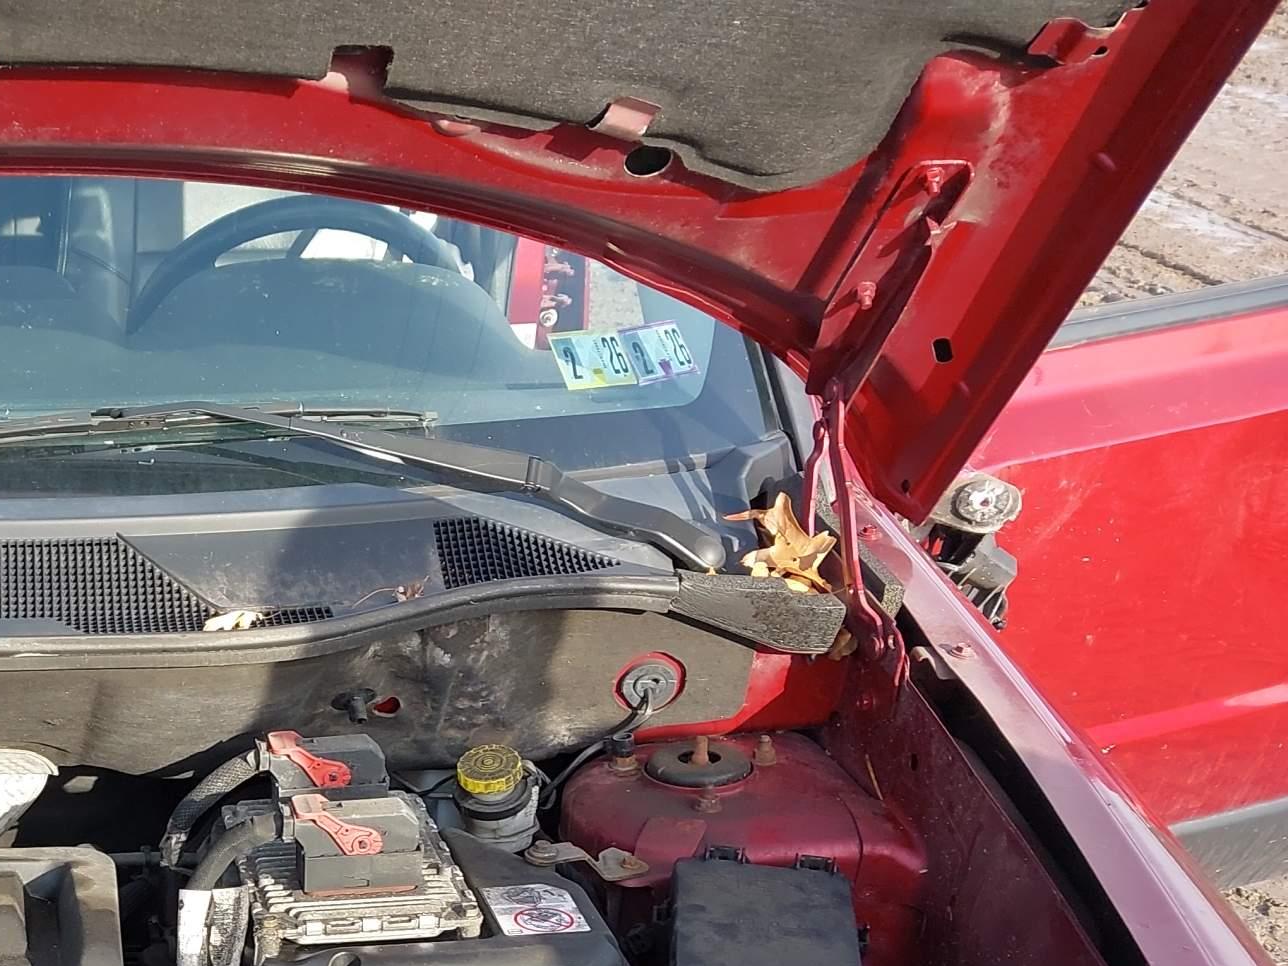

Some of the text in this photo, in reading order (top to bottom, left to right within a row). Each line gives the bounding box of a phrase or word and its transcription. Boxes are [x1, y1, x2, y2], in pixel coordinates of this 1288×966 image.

[562, 346, 584, 380] 2
[600, 336, 629, 374] 26
[631, 341, 654, 375] 2
[663, 327, 692, 366] 26
